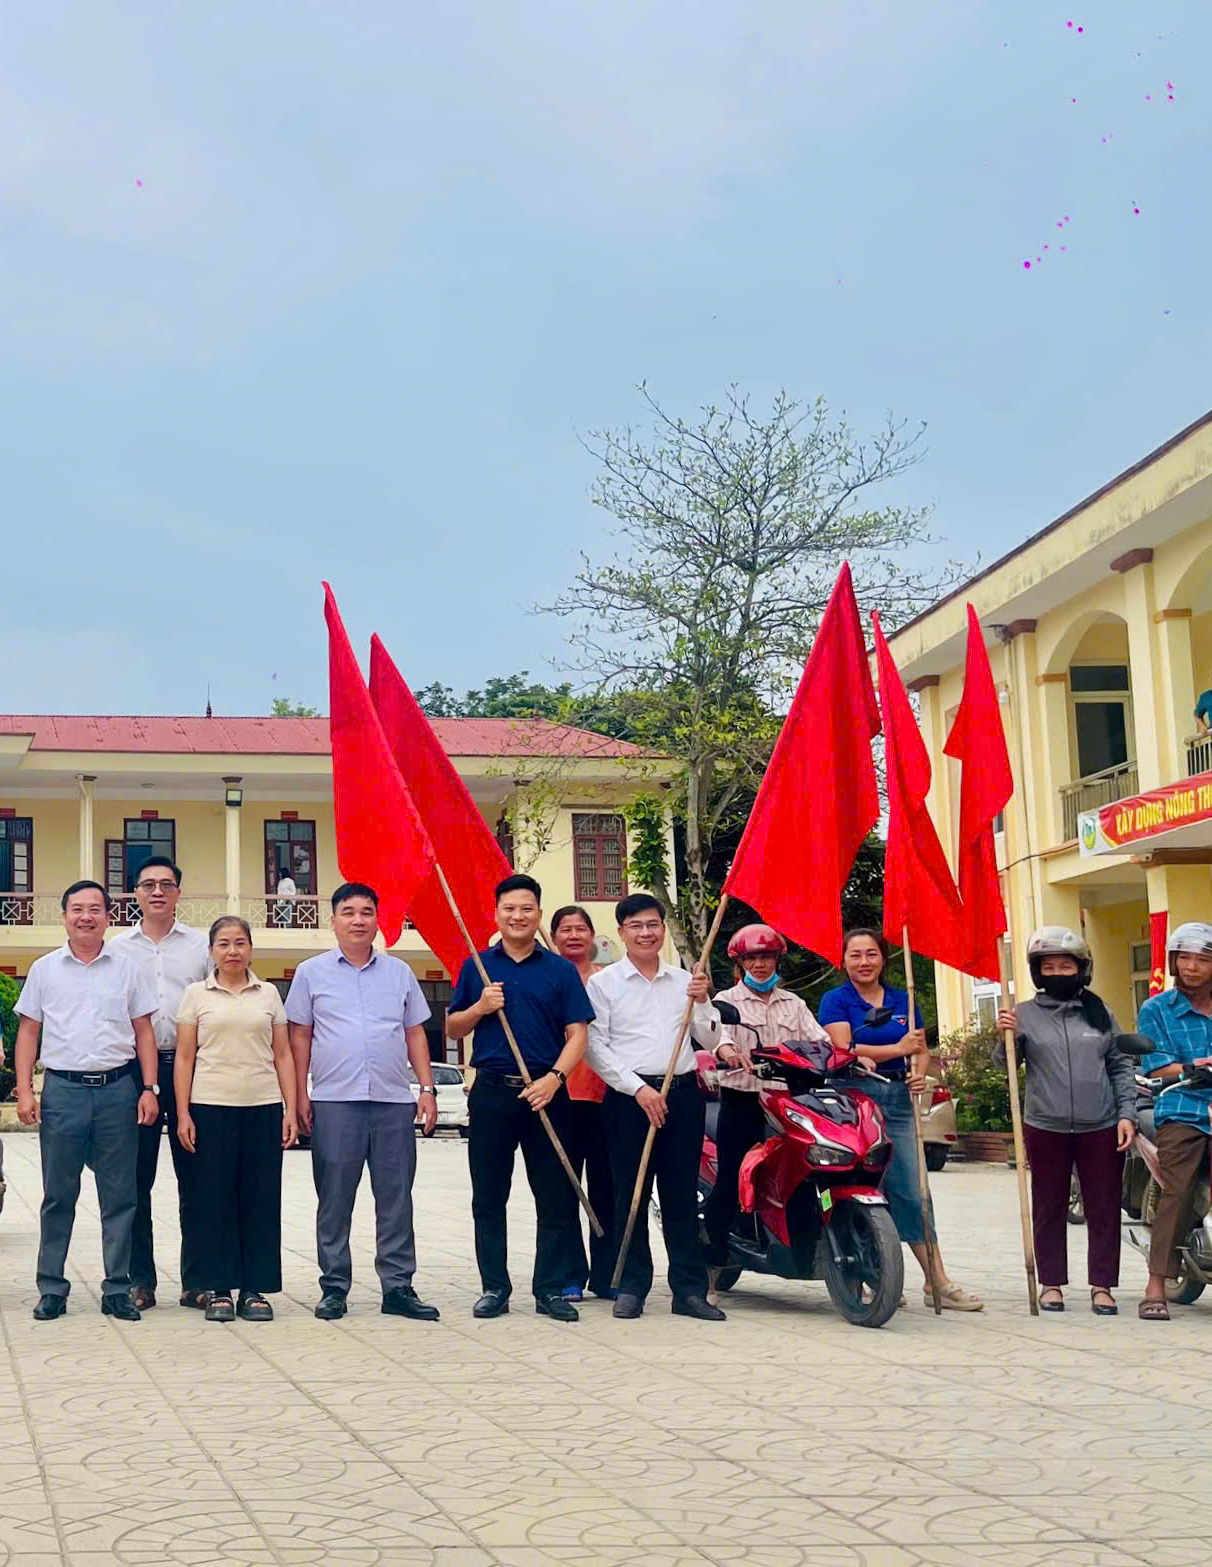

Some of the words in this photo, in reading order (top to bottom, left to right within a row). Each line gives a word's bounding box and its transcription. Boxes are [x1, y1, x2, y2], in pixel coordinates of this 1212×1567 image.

[1116, 807, 1133, 836] XÂY
[1135, 800, 1164, 833] DỰNG
[1165, 789, 1195, 821] NÔNG
[1197, 783, 1212, 811] TH
